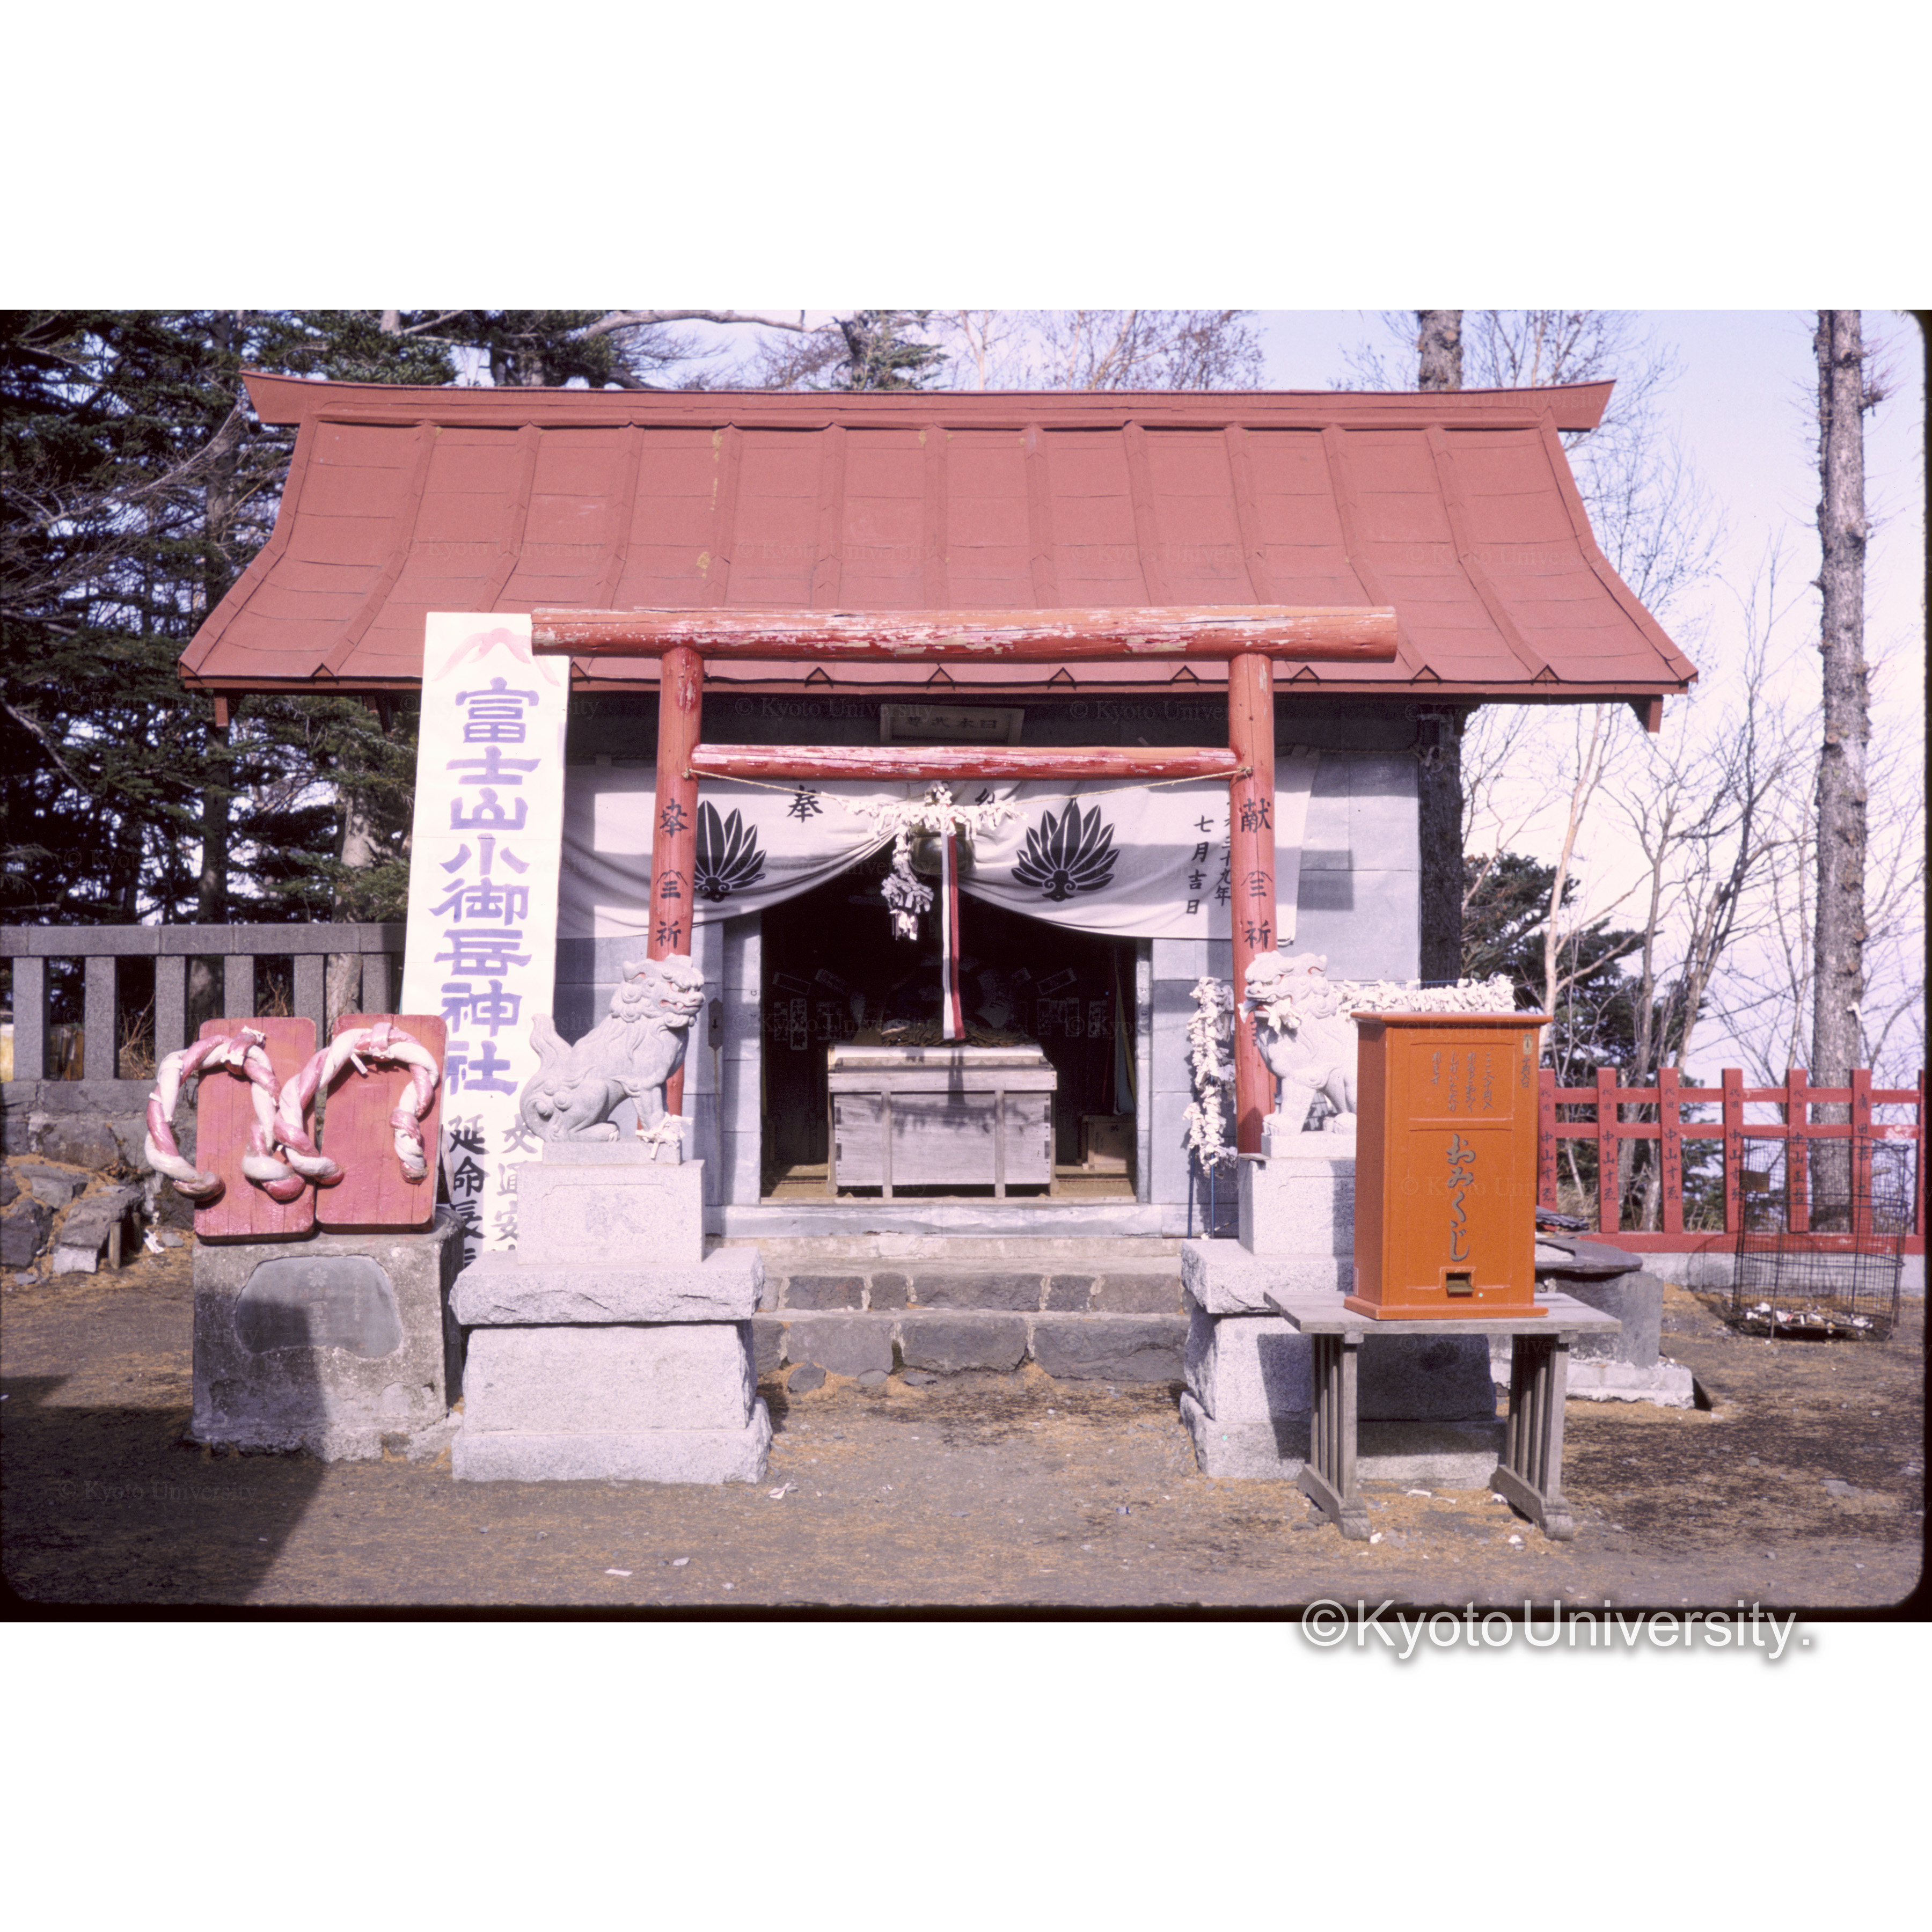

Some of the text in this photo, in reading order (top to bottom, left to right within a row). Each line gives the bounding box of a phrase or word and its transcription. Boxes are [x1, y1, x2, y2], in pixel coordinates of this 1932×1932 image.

[786, 785, 823, 823] 奉
[1185, 815, 1214, 914] 七月吉日
[448, 1114, 491, 1272] 延命長
[489, 1113, 538, 1251] 交通安
[1446, 1133, 1476, 1262] おみくじ
